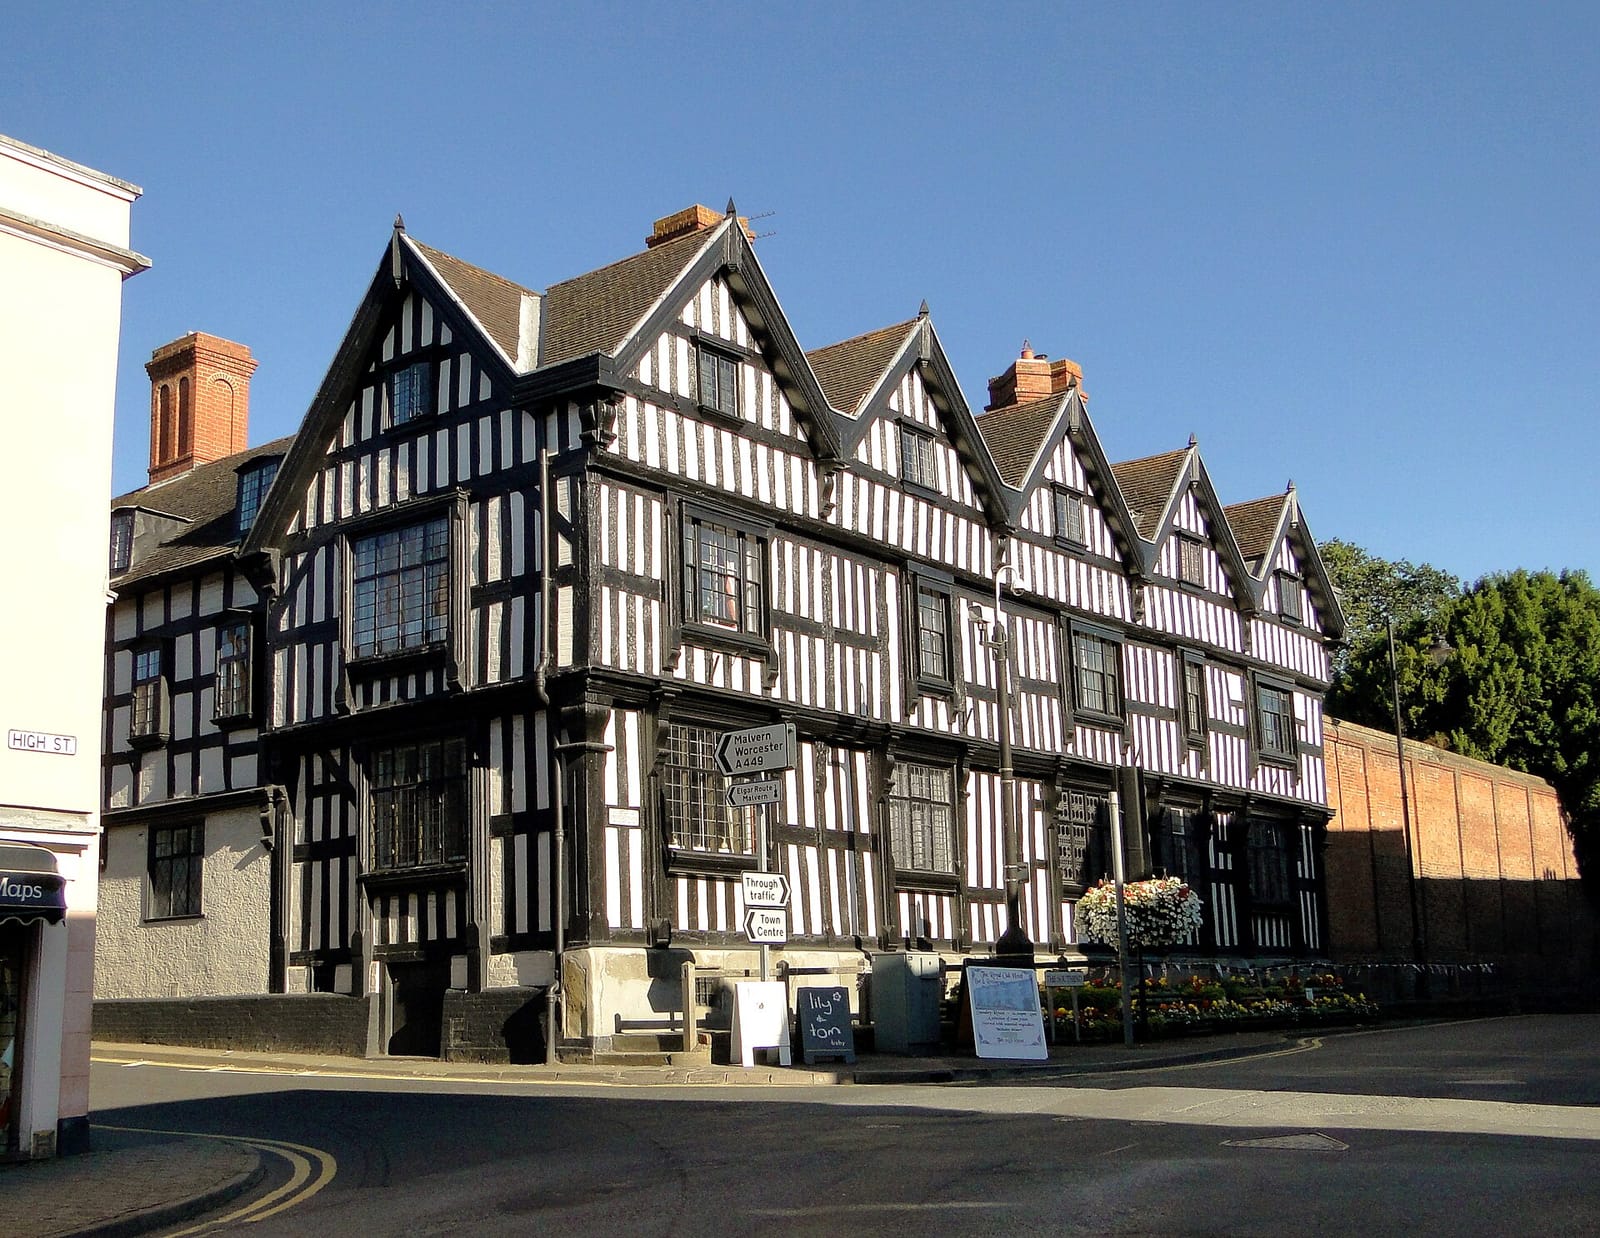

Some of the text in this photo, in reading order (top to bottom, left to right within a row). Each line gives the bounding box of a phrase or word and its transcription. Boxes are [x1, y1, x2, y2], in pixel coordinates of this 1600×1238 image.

[13, 732, 46, 749] HIGH
[734, 732, 771, 745] Malvern
[735, 742, 783, 757] Worcester
[737, 785, 773, 796] Elgar Route
[742, 793, 768, 802] Malvern
[745, 877, 778, 890] Through
[750, 890, 775, 901] traffic
[760, 914, 781, 924] Town
[757, 926, 784, 937] Centre
[809, 992, 833, 1015] lily
[809, 1023, 842, 1039] tom
